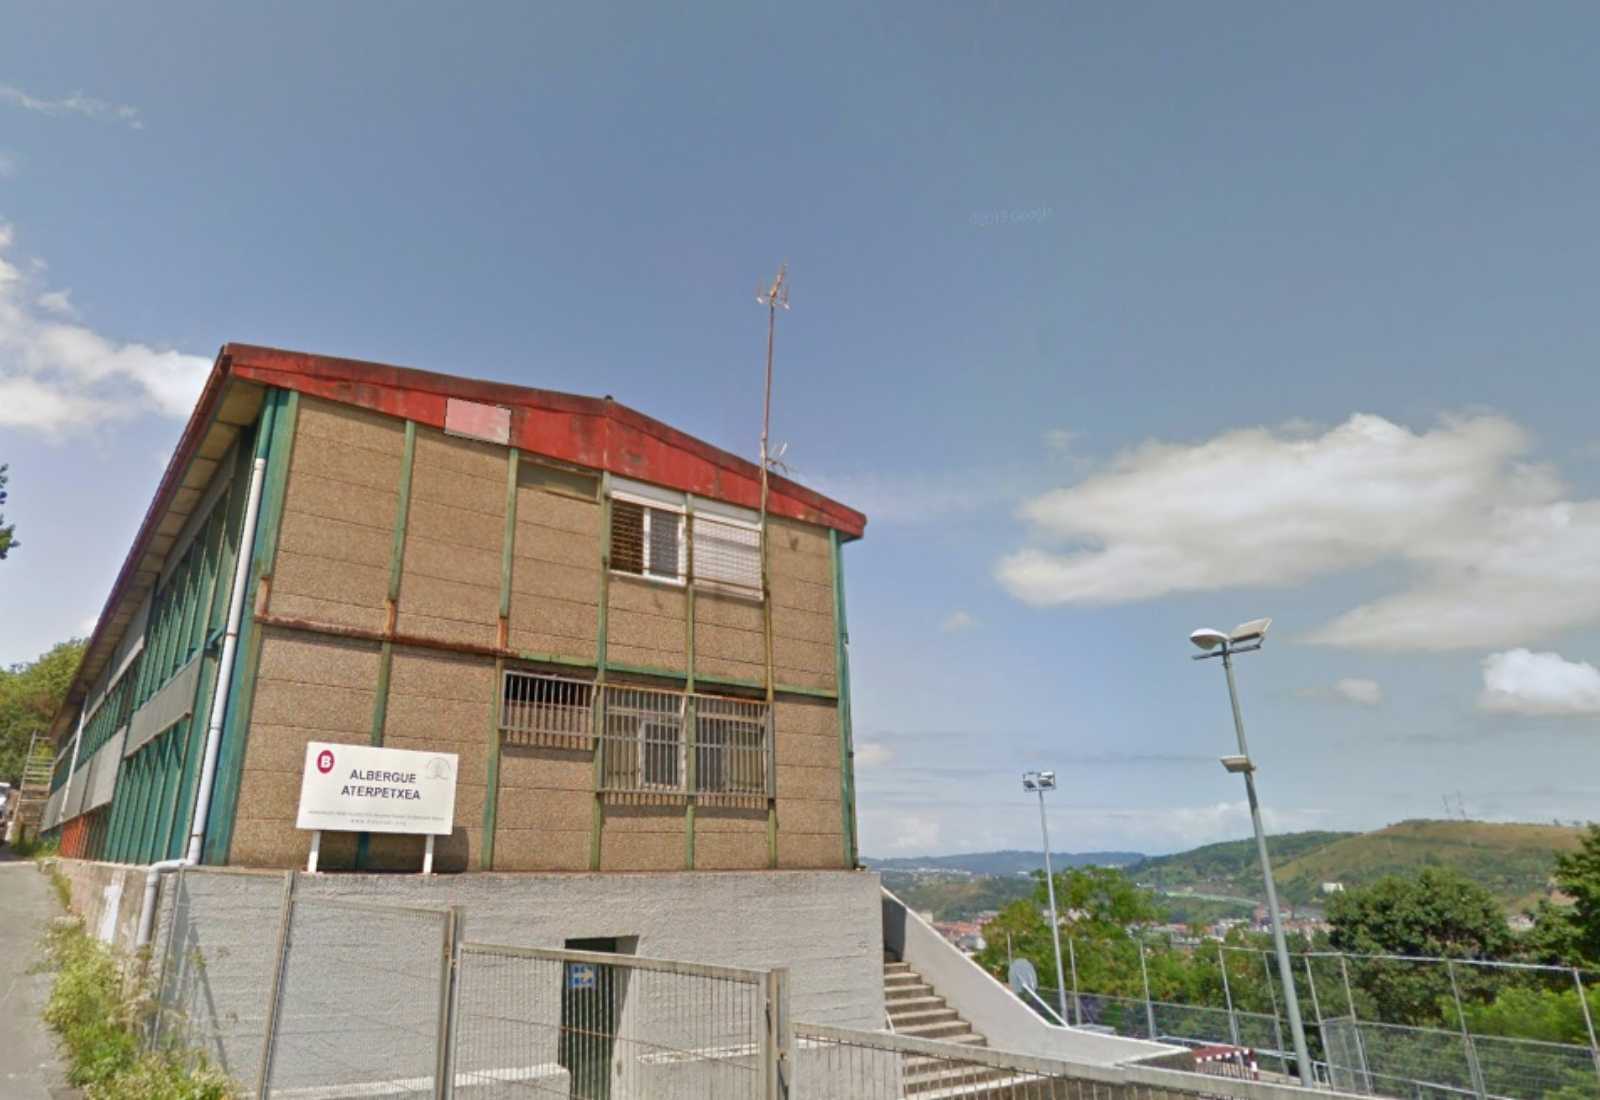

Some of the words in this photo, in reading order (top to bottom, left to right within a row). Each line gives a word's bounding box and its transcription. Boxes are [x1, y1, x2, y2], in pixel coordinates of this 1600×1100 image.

[320, 755, 331, 769] B
[350, 769, 416, 783] ALBERGUE
[341, 786, 421, 800] ATERPETXEA
